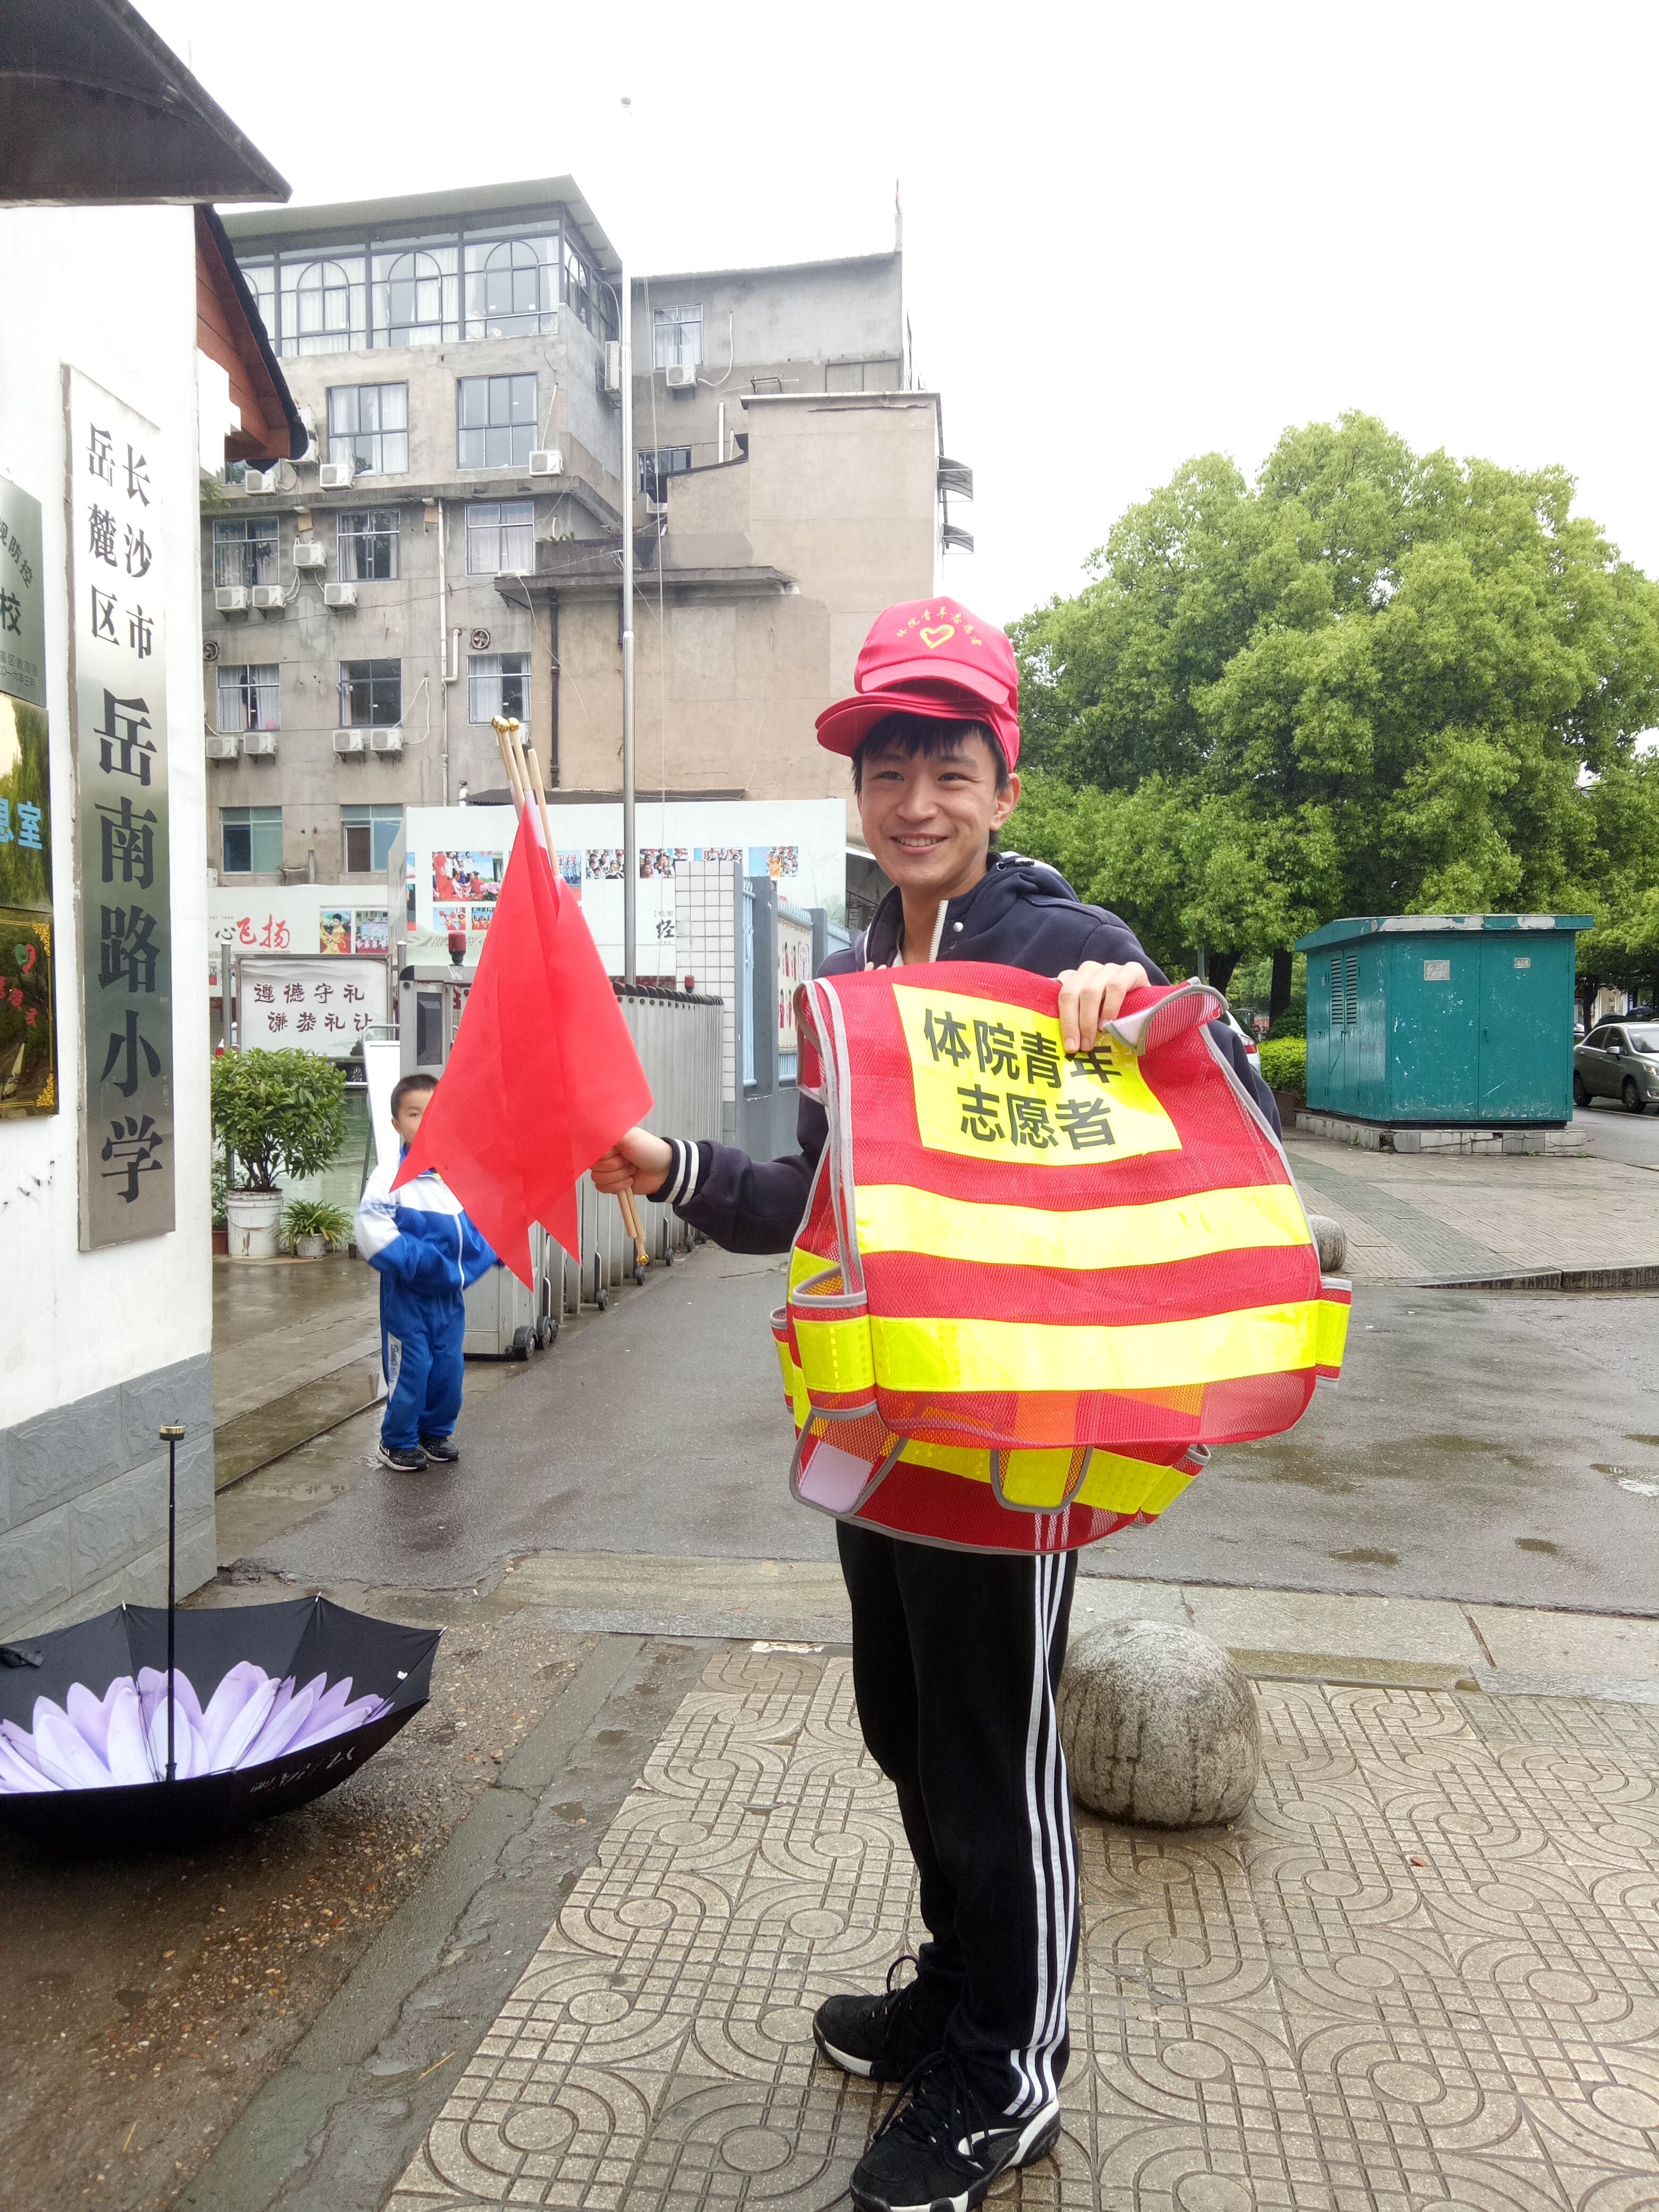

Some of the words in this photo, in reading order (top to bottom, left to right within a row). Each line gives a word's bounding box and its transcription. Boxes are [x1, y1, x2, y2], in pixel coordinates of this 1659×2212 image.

[86, 422, 119, 646] 岳麓区
[123, 443, 154, 659] 长沙市
[93, 688, 164, 1203] 岳南路小学
[254, 982, 365, 1004] 遵德守礼
[267, 1011, 372, 1033] 谦恭礼让
[923, 1008, 1122, 1088] 体院青年
[957, 1084, 1116, 1151] 志愿者
